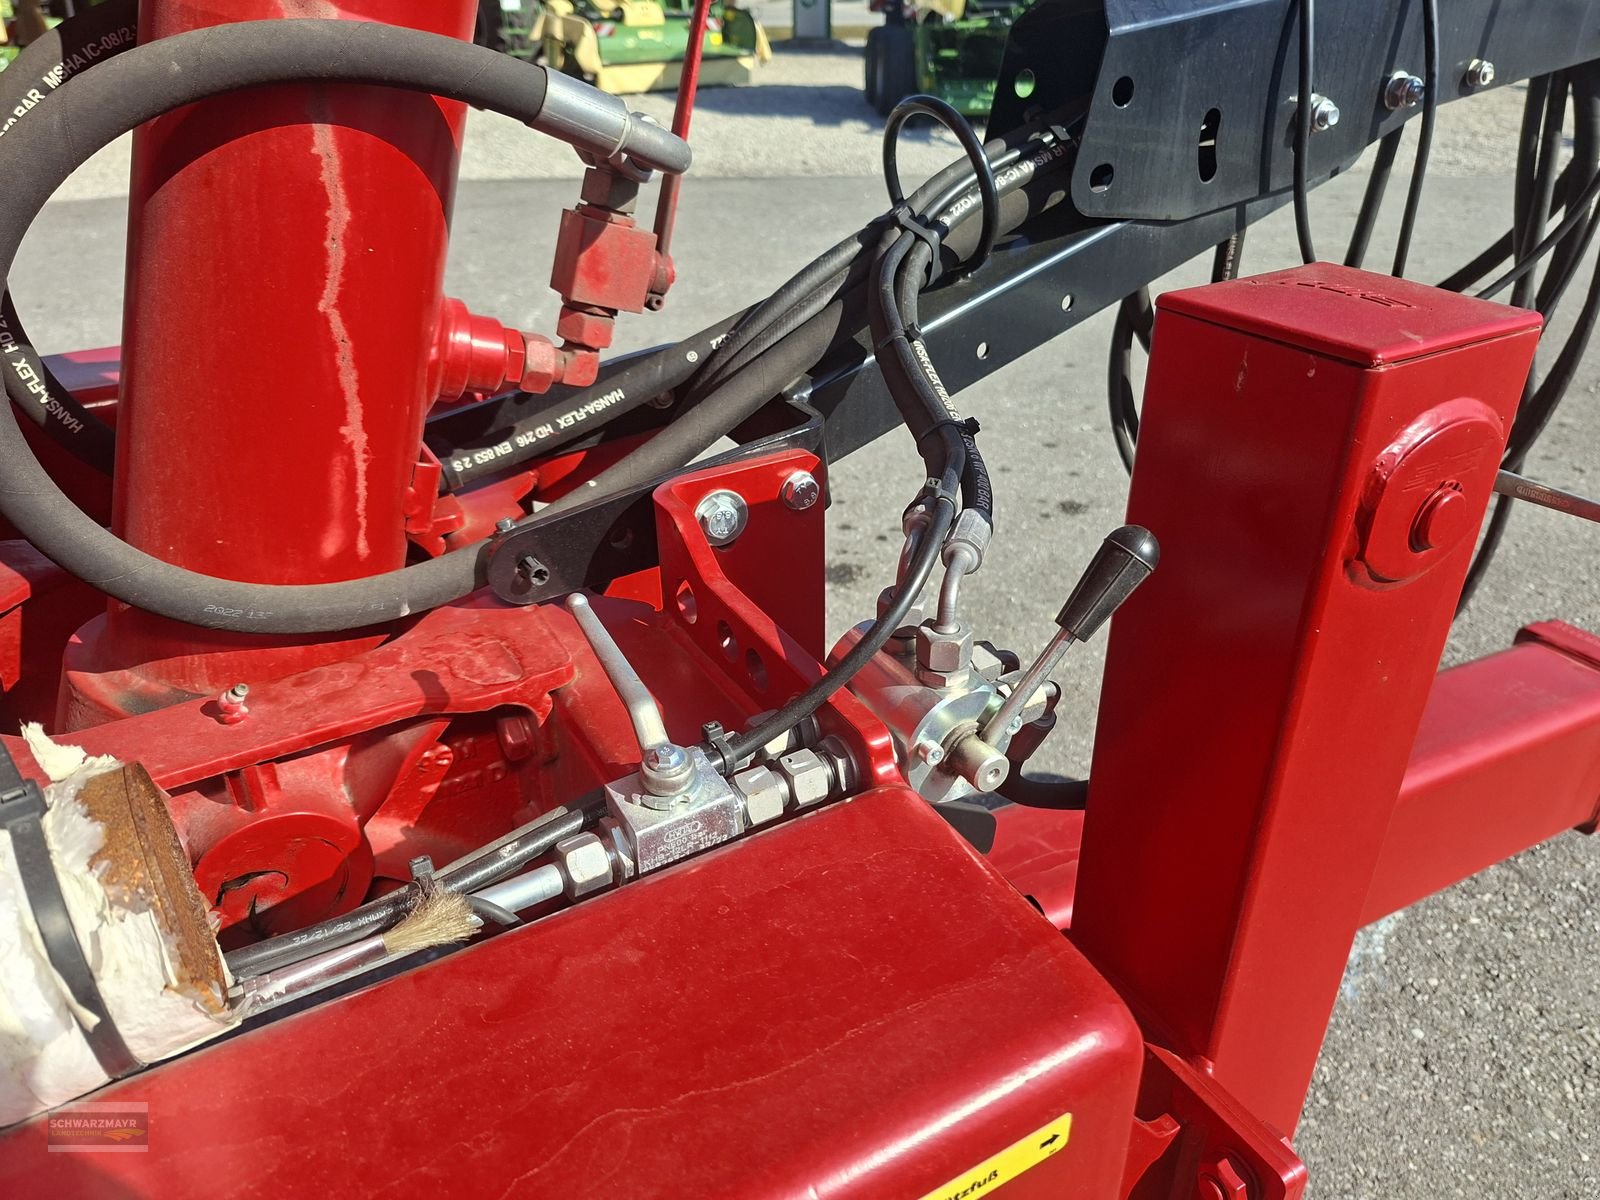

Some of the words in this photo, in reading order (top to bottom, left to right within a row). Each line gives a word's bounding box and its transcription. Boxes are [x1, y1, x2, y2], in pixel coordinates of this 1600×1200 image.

[14, 88, 46, 118] BAR
[42, 53, 87, 89] MSHA
[83, 24, 138, 60] IC-08/2
[0, 331, 20, 353] HD
[12, 357, 84, 434] HANSA-FLEX
[559, 389, 626, 430] HANSA-FLEX
[516, 431, 537, 447] 216
[535, 424, 554, 439] HD
[473, 449, 495, 464] 853
[493, 441, 513, 457] EN
[976, 487, 991, 511] BAR
[293, 921, 352, 946] 22/12/22
